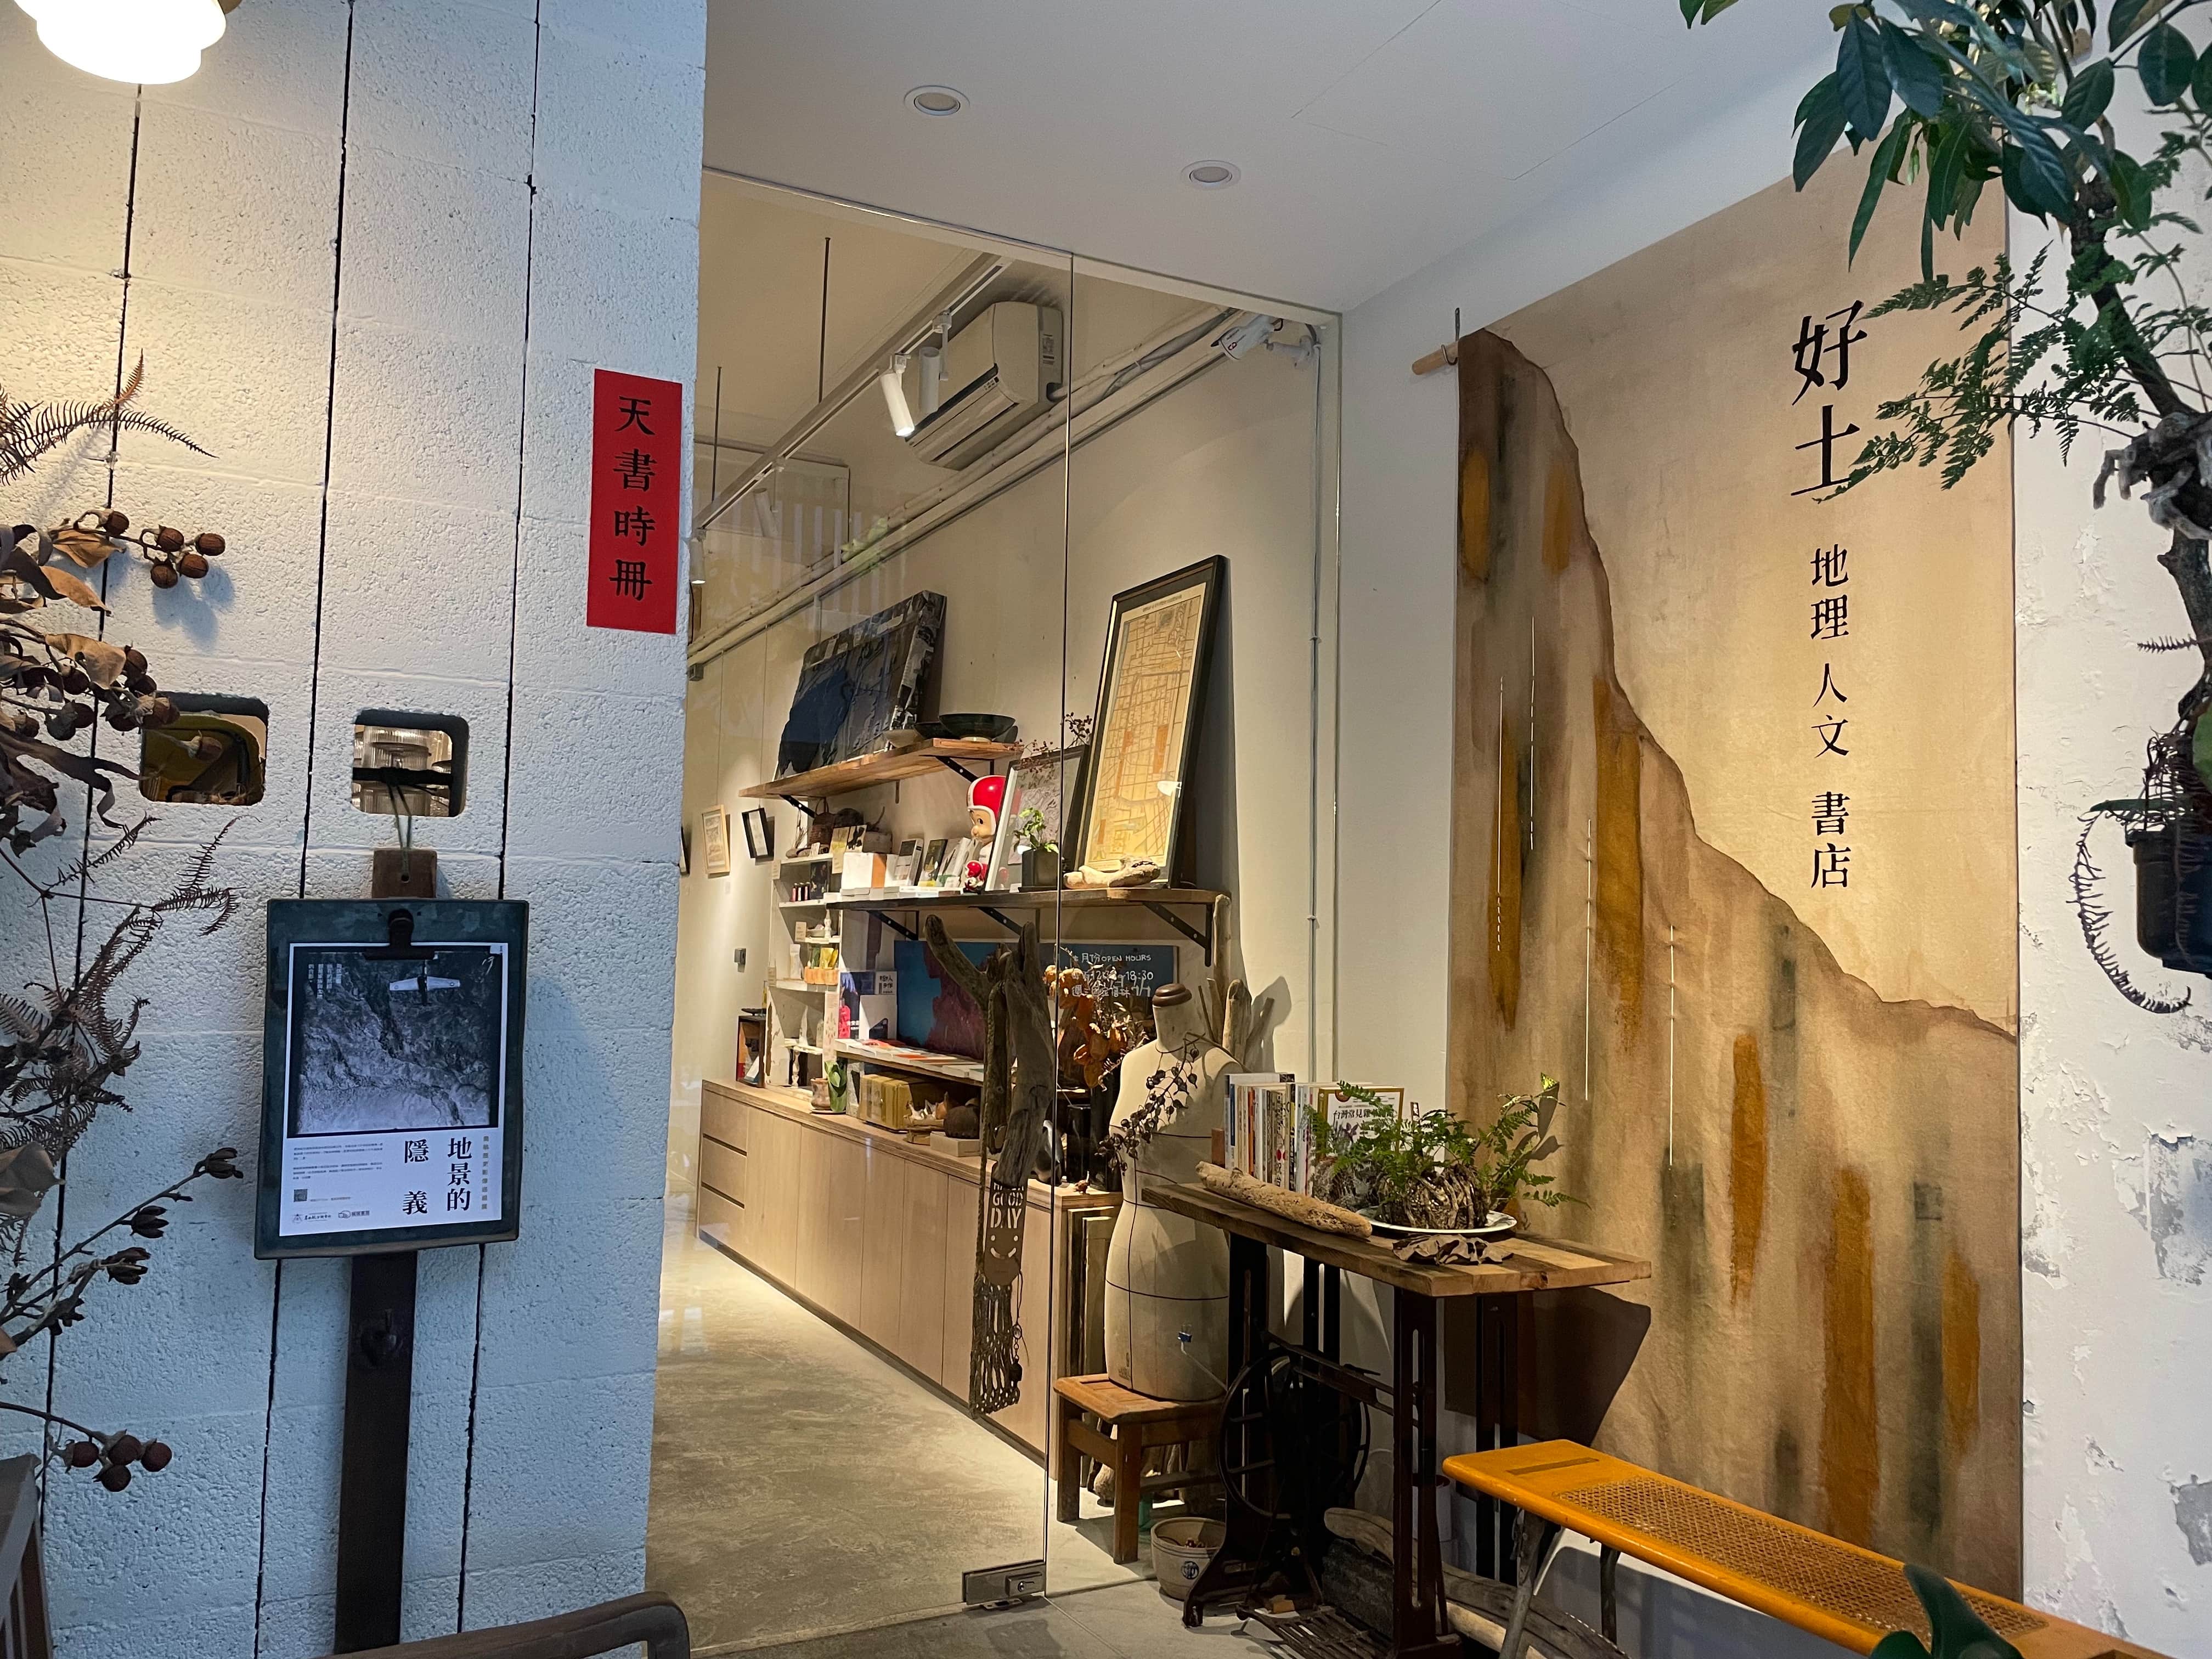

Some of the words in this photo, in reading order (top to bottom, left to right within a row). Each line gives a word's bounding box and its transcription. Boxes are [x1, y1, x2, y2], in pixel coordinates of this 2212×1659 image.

[1791, 300, 1867, 495] 好土
[609, 396, 658, 601] 天書時冊
[402, 1139, 429, 1215] 隱義
[447, 1137, 472, 1212] 地景的
